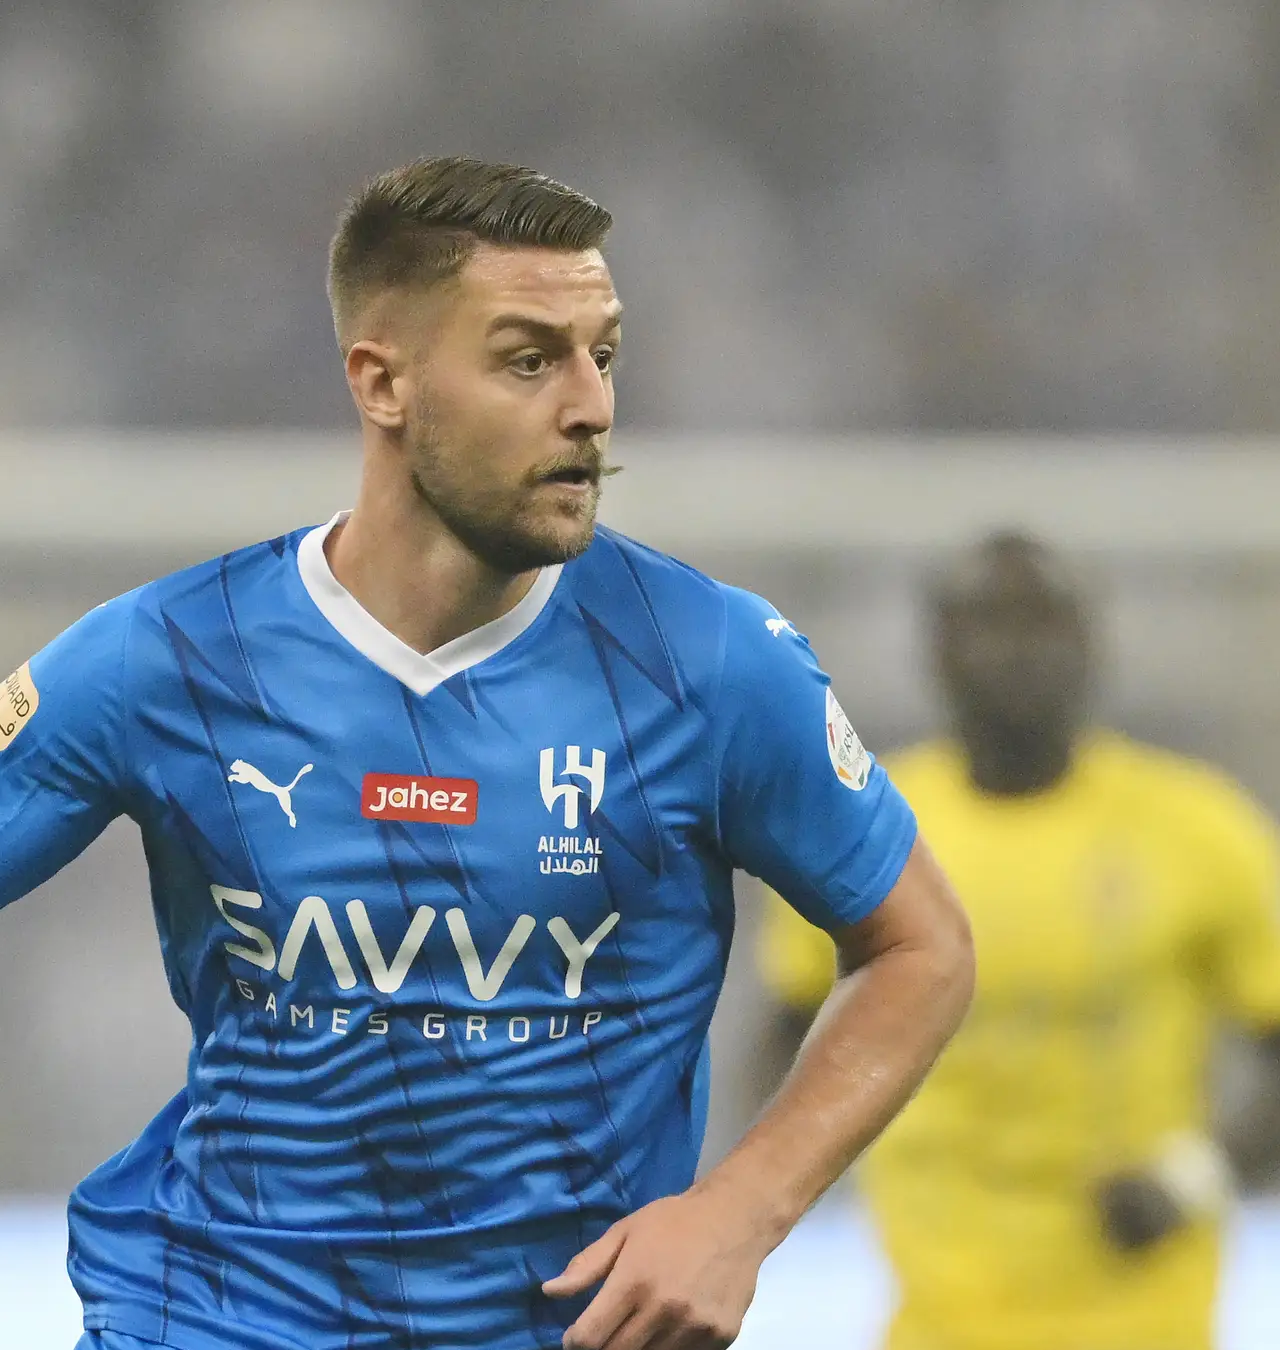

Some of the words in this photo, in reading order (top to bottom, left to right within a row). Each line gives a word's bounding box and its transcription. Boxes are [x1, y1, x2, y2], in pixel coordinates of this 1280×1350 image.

[368, 781, 468, 812] jahez
[537, 835, 603, 855] ALHILAL
[539, 855, 599, 876] الهلال
[210, 884, 620, 1001] SAVVY
[235, 978, 389, 1036] GAMES
[422, 1011, 602, 1043] GROUP
